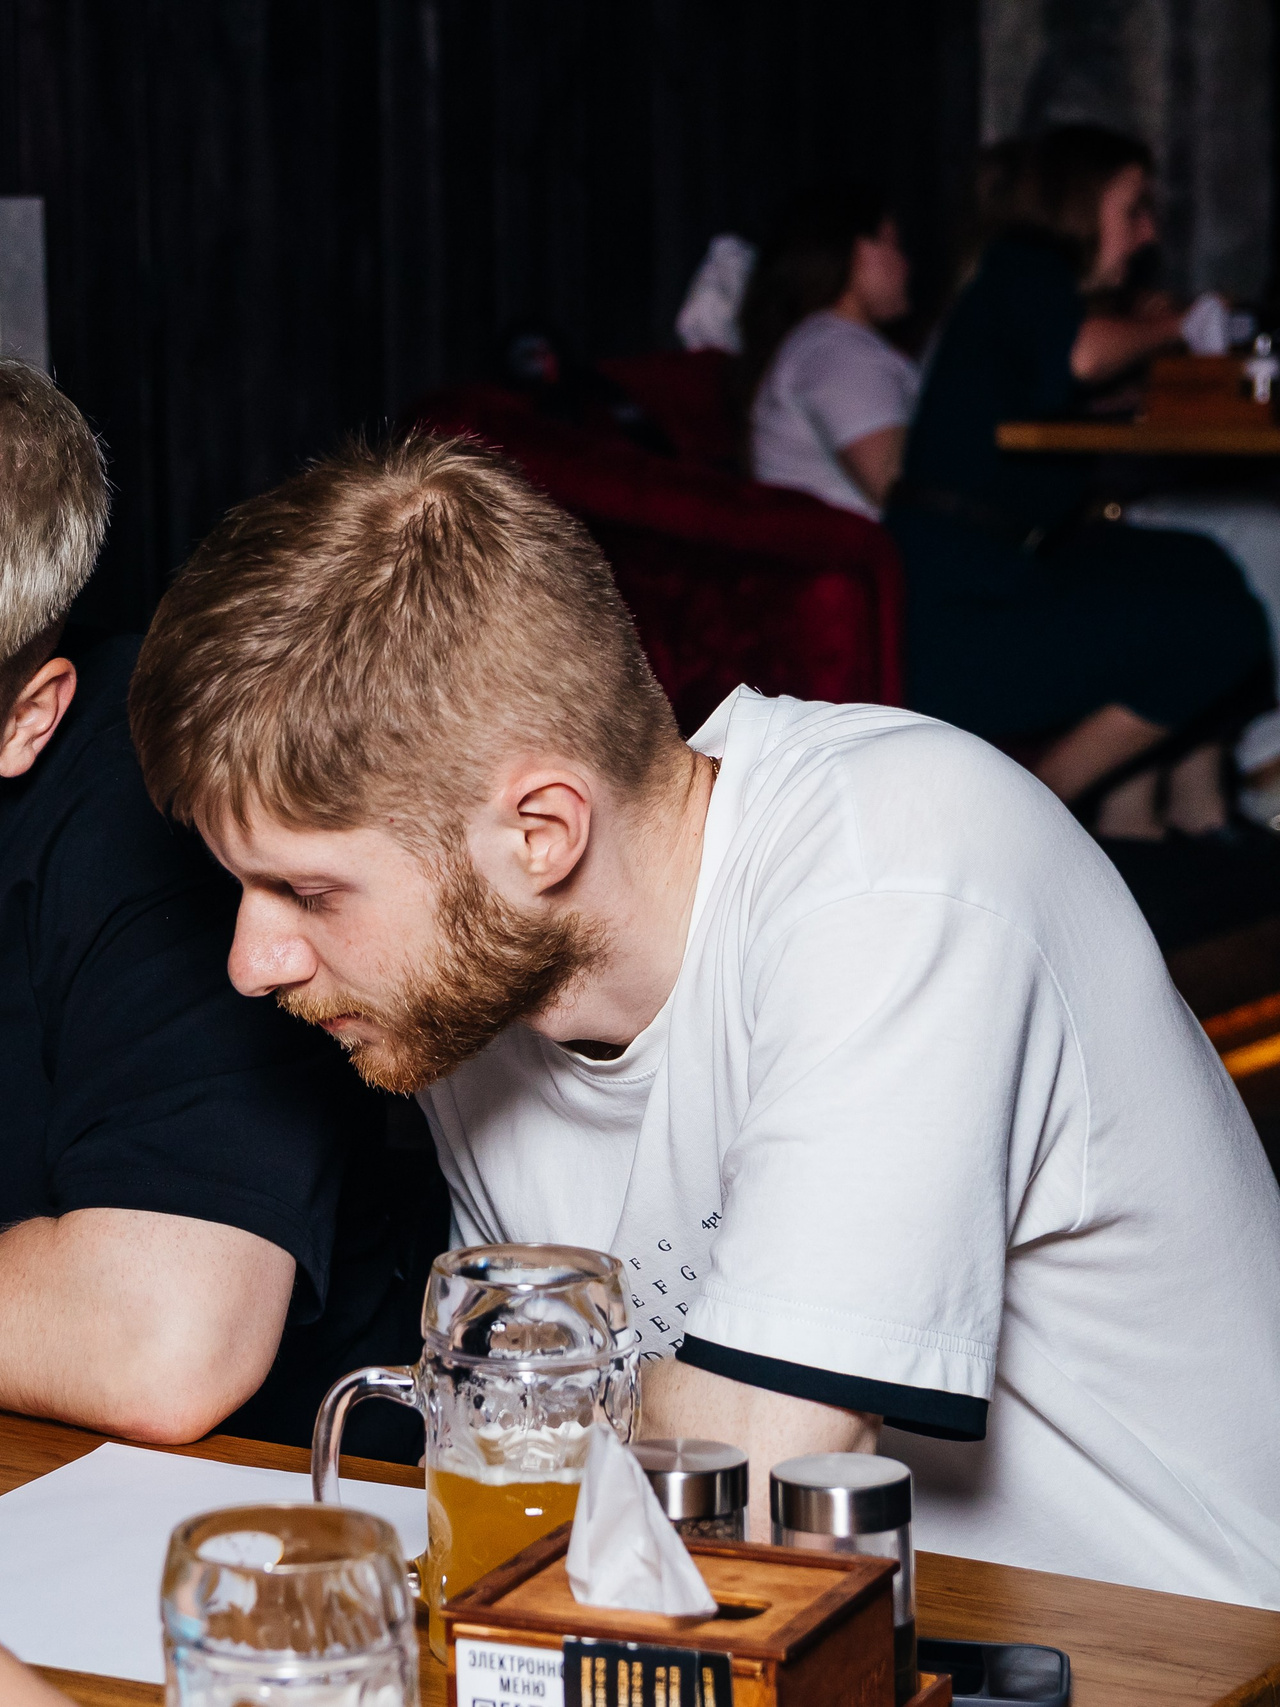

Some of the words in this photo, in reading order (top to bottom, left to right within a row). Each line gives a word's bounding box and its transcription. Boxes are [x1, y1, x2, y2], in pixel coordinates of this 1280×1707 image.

[701, 1211, 723, 1230] 4pt
[657, 1239, 673, 1252] G
[680, 1265, 698, 1281] G
[500, 1676, 547, 1697] МЕНЮ
